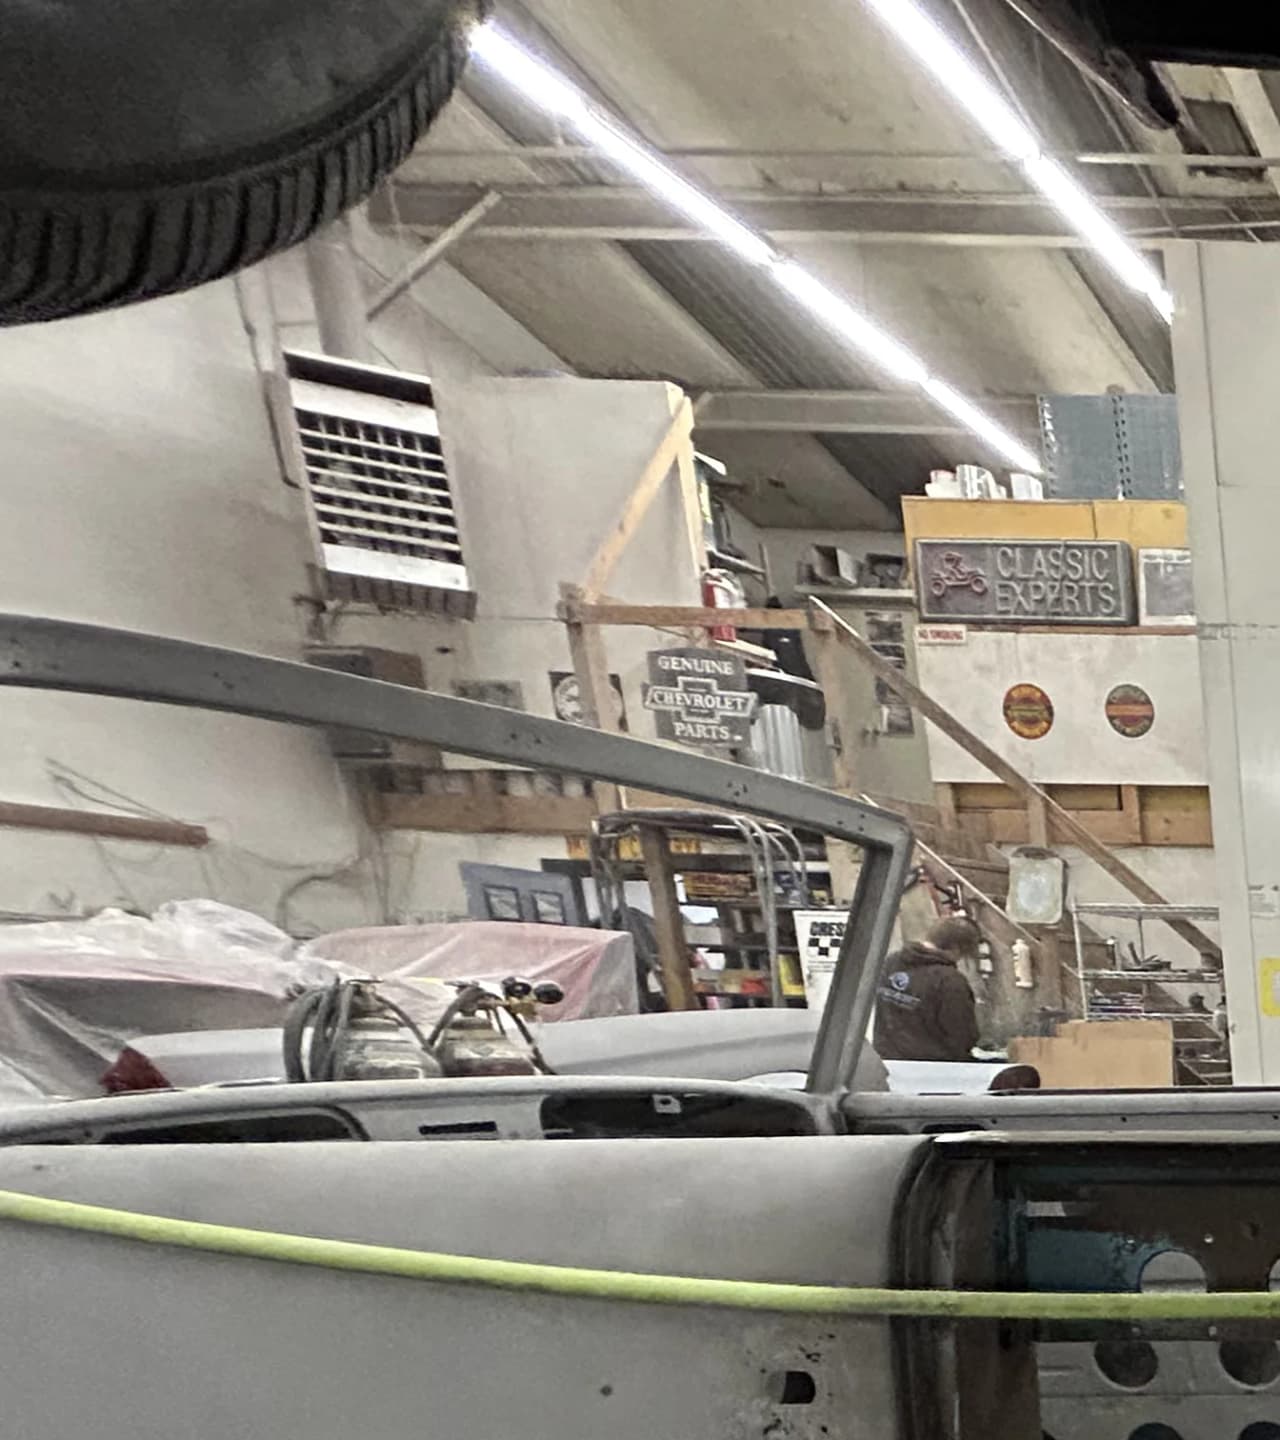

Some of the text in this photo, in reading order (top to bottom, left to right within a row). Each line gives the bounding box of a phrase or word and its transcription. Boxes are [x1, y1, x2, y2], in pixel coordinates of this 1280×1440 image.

[996, 547, 1108, 580] CLASSIC
[996, 581, 1115, 615] EXPERTS
[658, 656, 734, 675] GENUINE
[653, 691, 745, 710] CHEVROLET
[673, 722, 730, 740] PARTS
